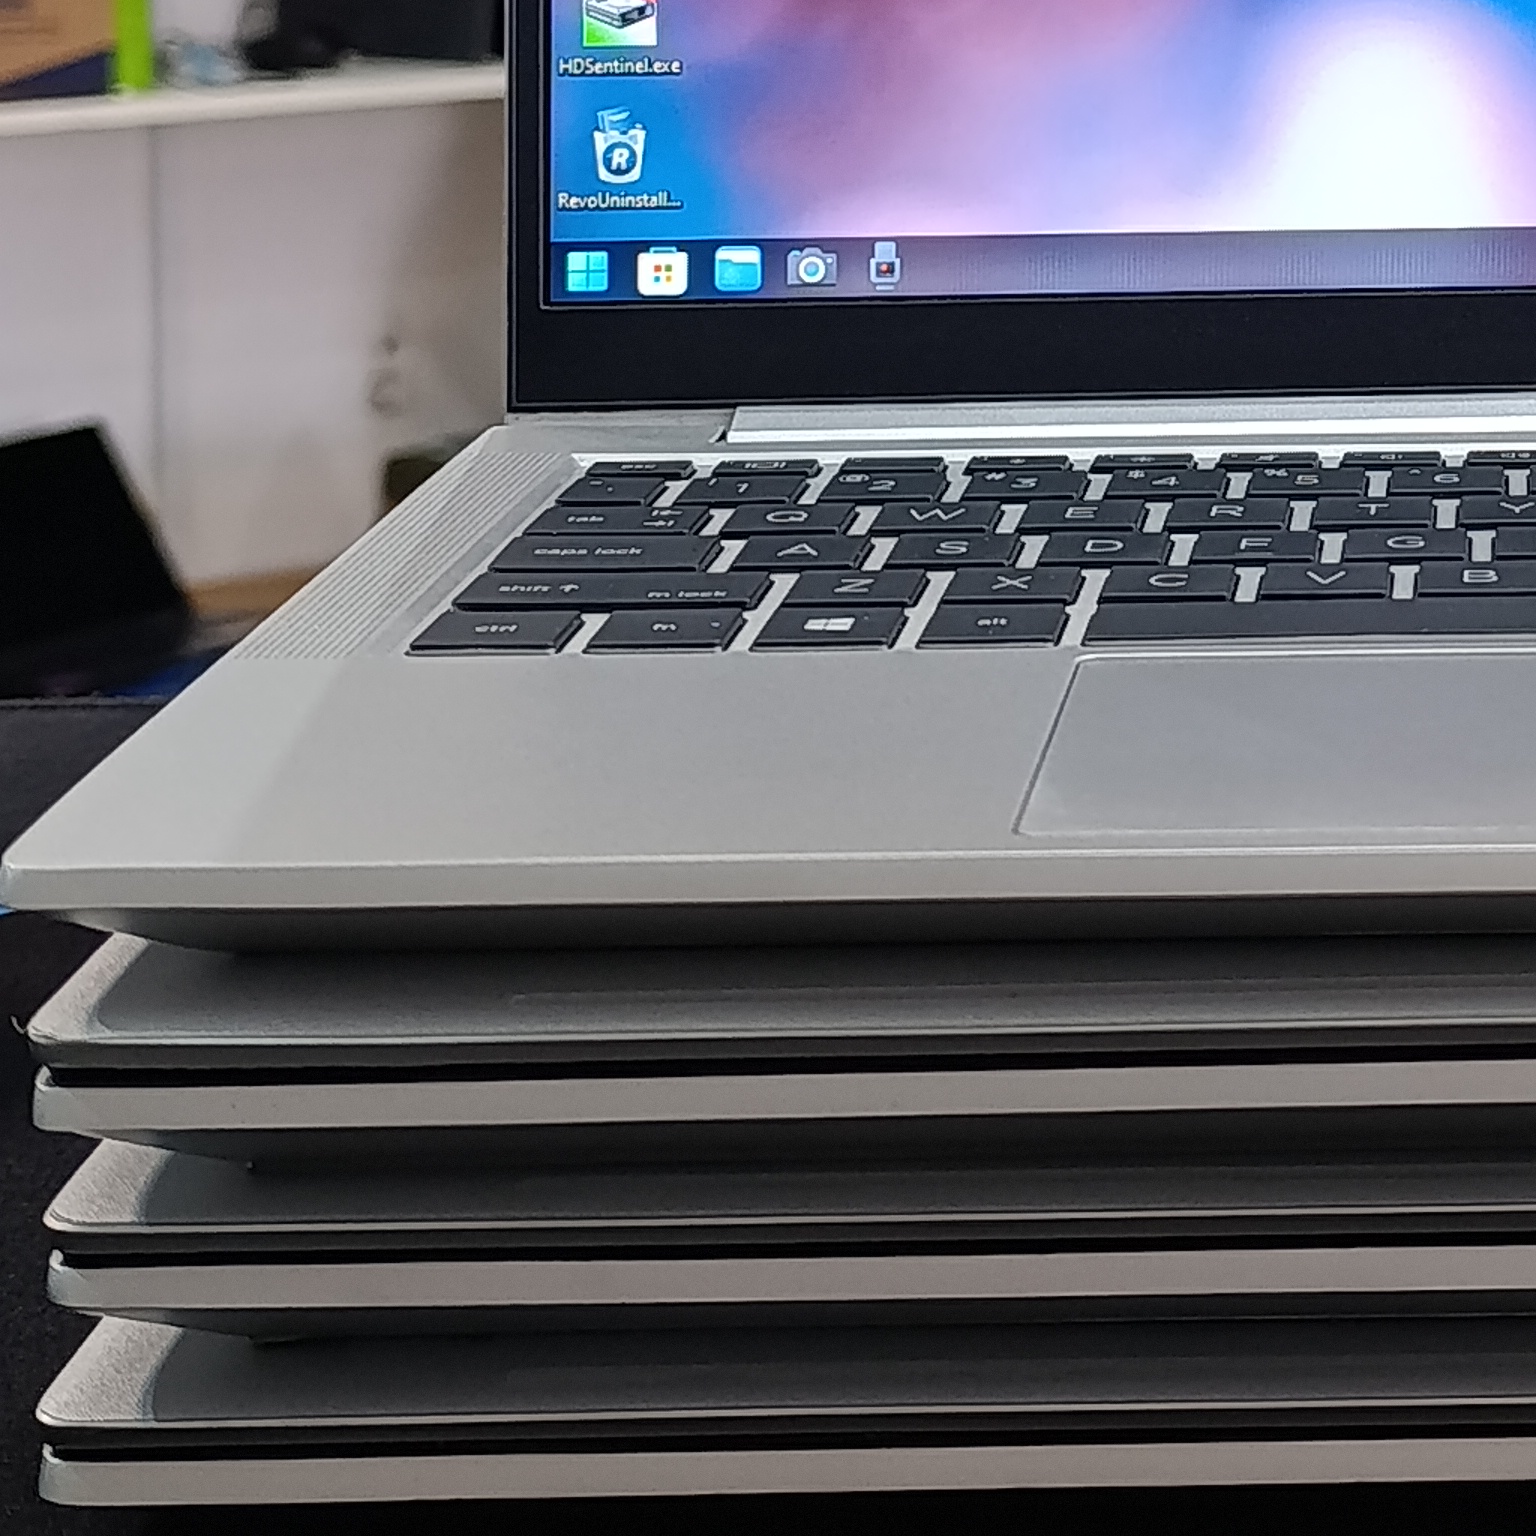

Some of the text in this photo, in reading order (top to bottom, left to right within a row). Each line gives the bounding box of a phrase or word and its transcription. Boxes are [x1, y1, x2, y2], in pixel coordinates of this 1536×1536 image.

[558, 57, 682, 74] HDSentinel.exe
[1010, 476, 1038, 489] 3
[1151, 476, 1180, 487] 4
[1293, 474, 1320, 486] 5
[1433, 473, 1461, 484] 6
[867, 480, 897, 492] 2
[909, 507, 967, 521] W
[1064, 506, 1100, 519] E
[1209, 504, 1245, 518] R
[1358, 503, 1390, 516] T
[1499, 501, 1535, 514] Y
[765, 509, 810, 523] Q
[934, 540, 971, 555] S
[1083, 539, 1125, 553] D
[1239, 537, 1274, 550] F
[1386, 535, 1426, 549] G
[594, 546, 644, 555] lock
[776, 543, 819, 558] A
[990, 574, 1034, 591] X
[1148, 573, 1190, 588] C
[1305, 570, 1347, 585] V
[1461, 568, 1499, 583] B
[833, 578, 875, 593] Z
